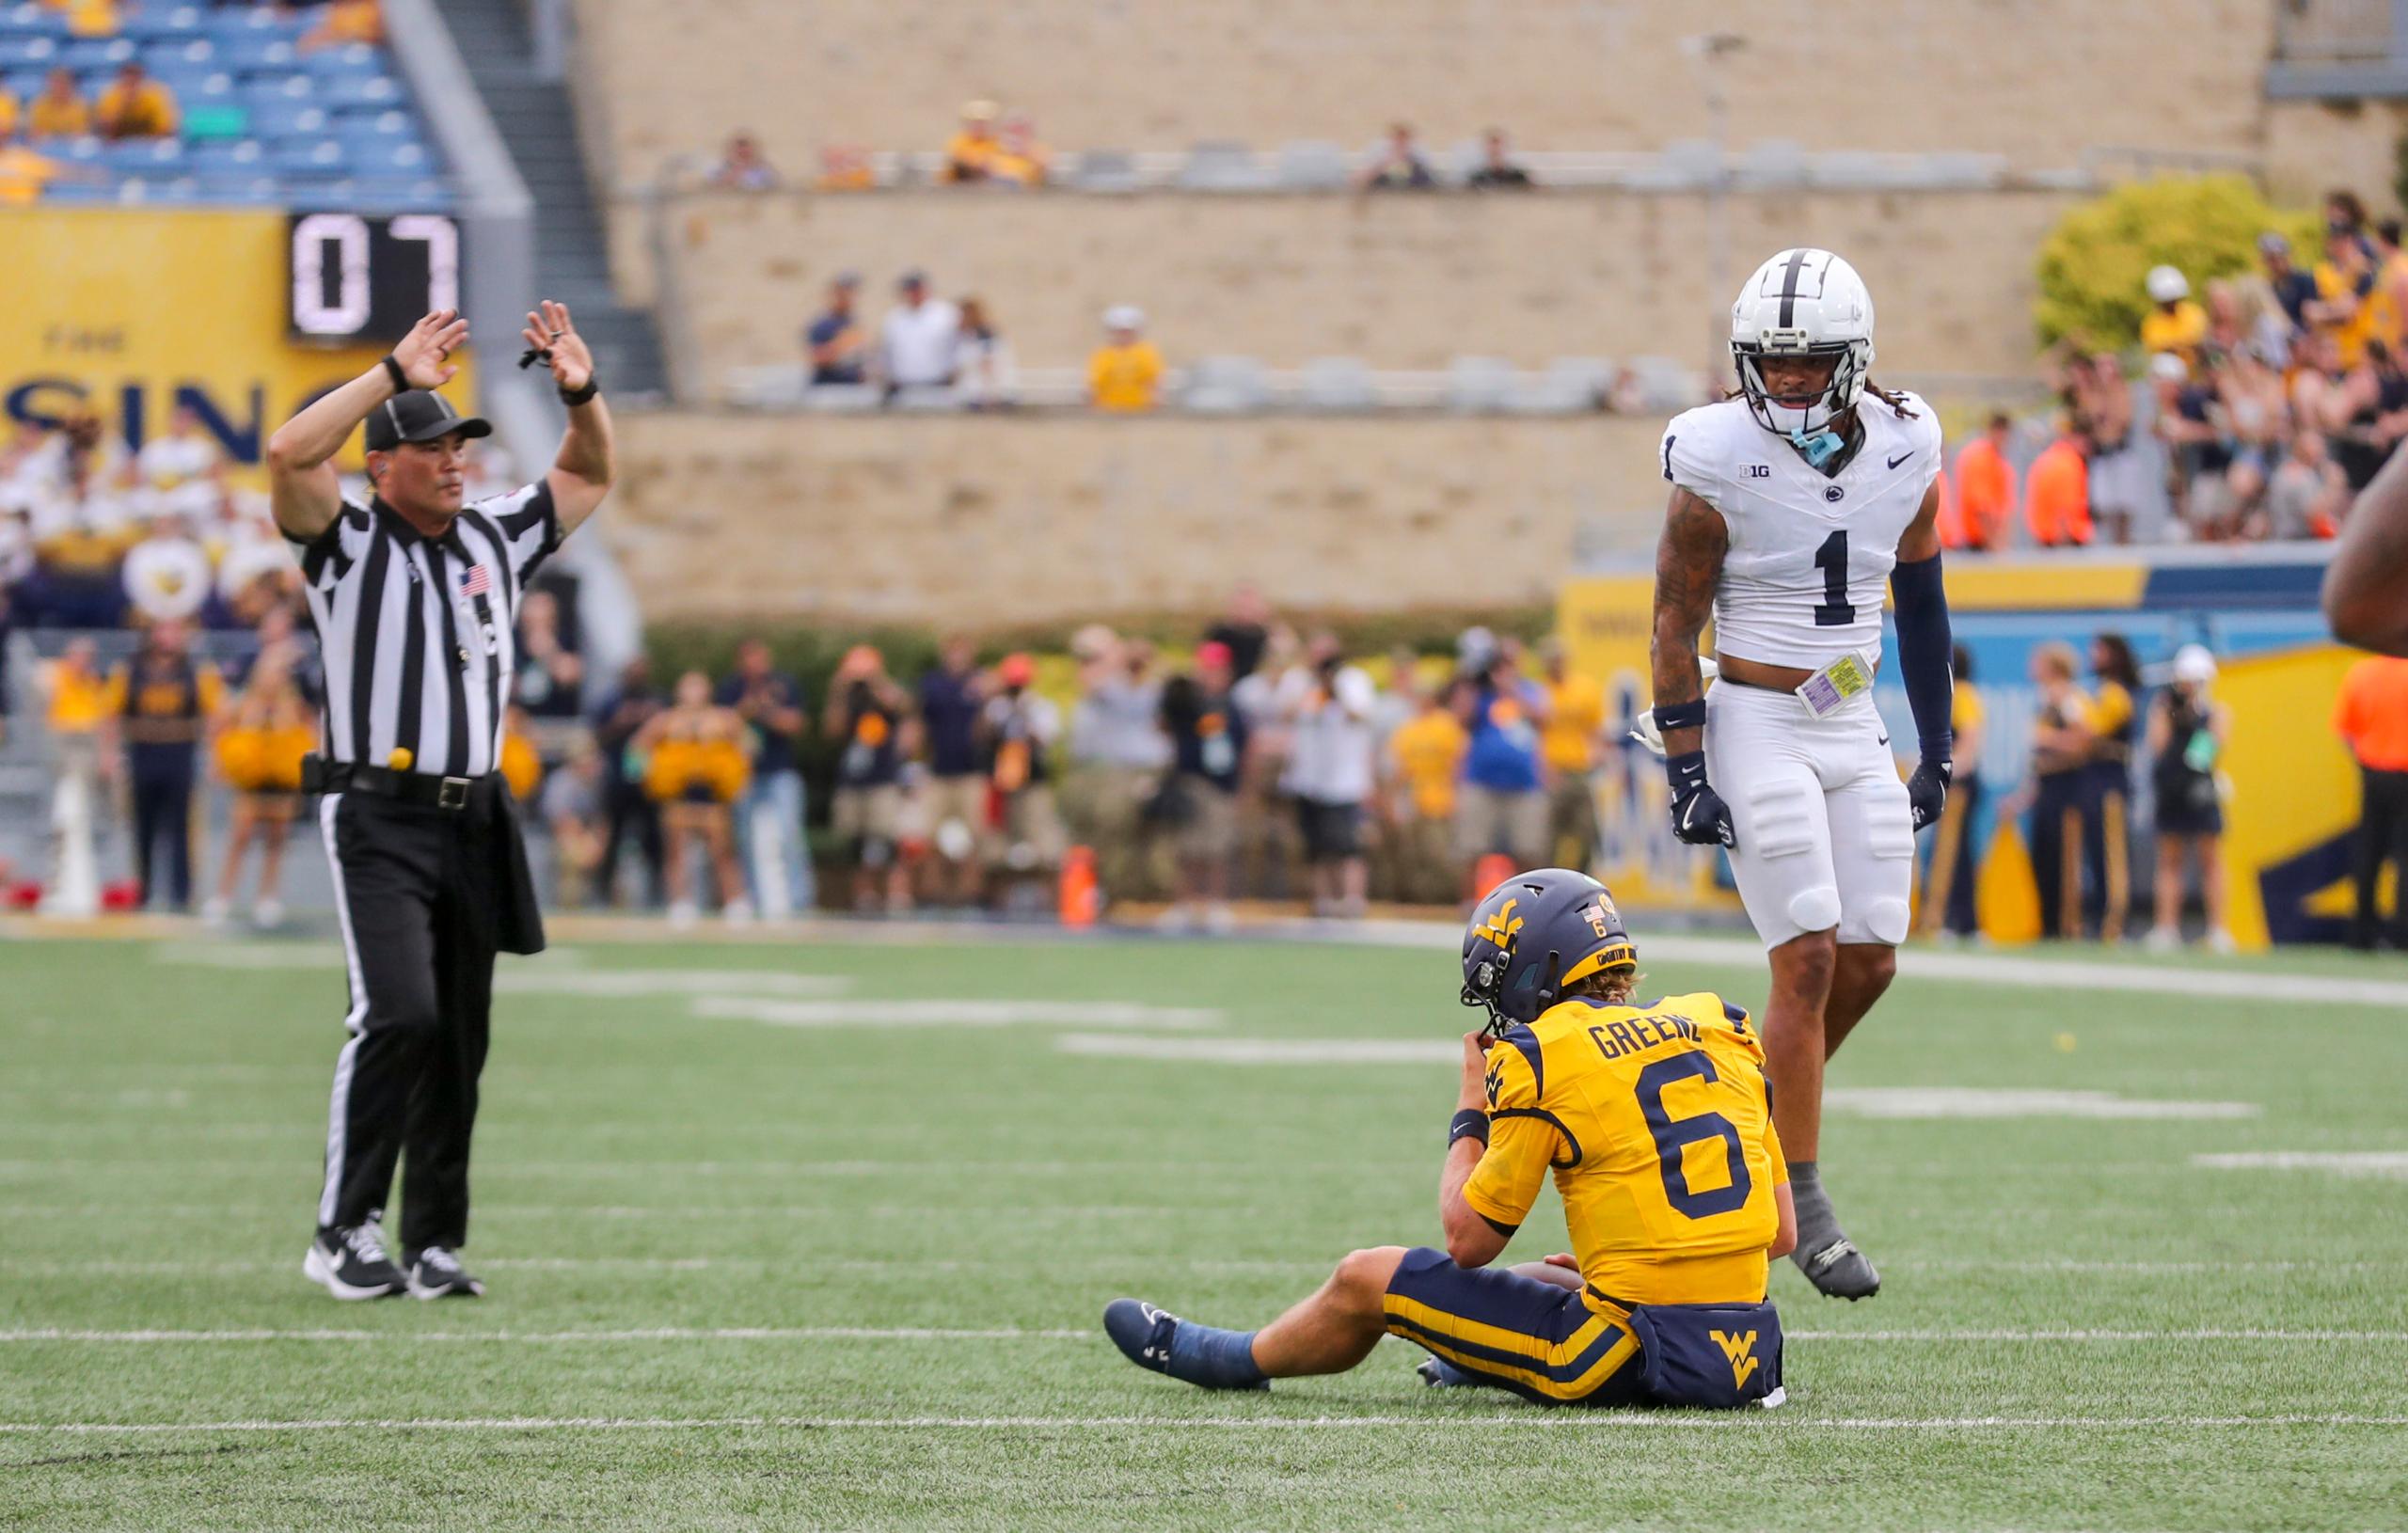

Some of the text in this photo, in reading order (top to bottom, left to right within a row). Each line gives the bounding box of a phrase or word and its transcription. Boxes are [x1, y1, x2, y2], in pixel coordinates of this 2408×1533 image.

[293, 213, 458, 335] 07
[1814, 529, 1856, 626] 1
[1592, 919, 1607, 938] 6
[1635, 1050, 1752, 1220] 6
